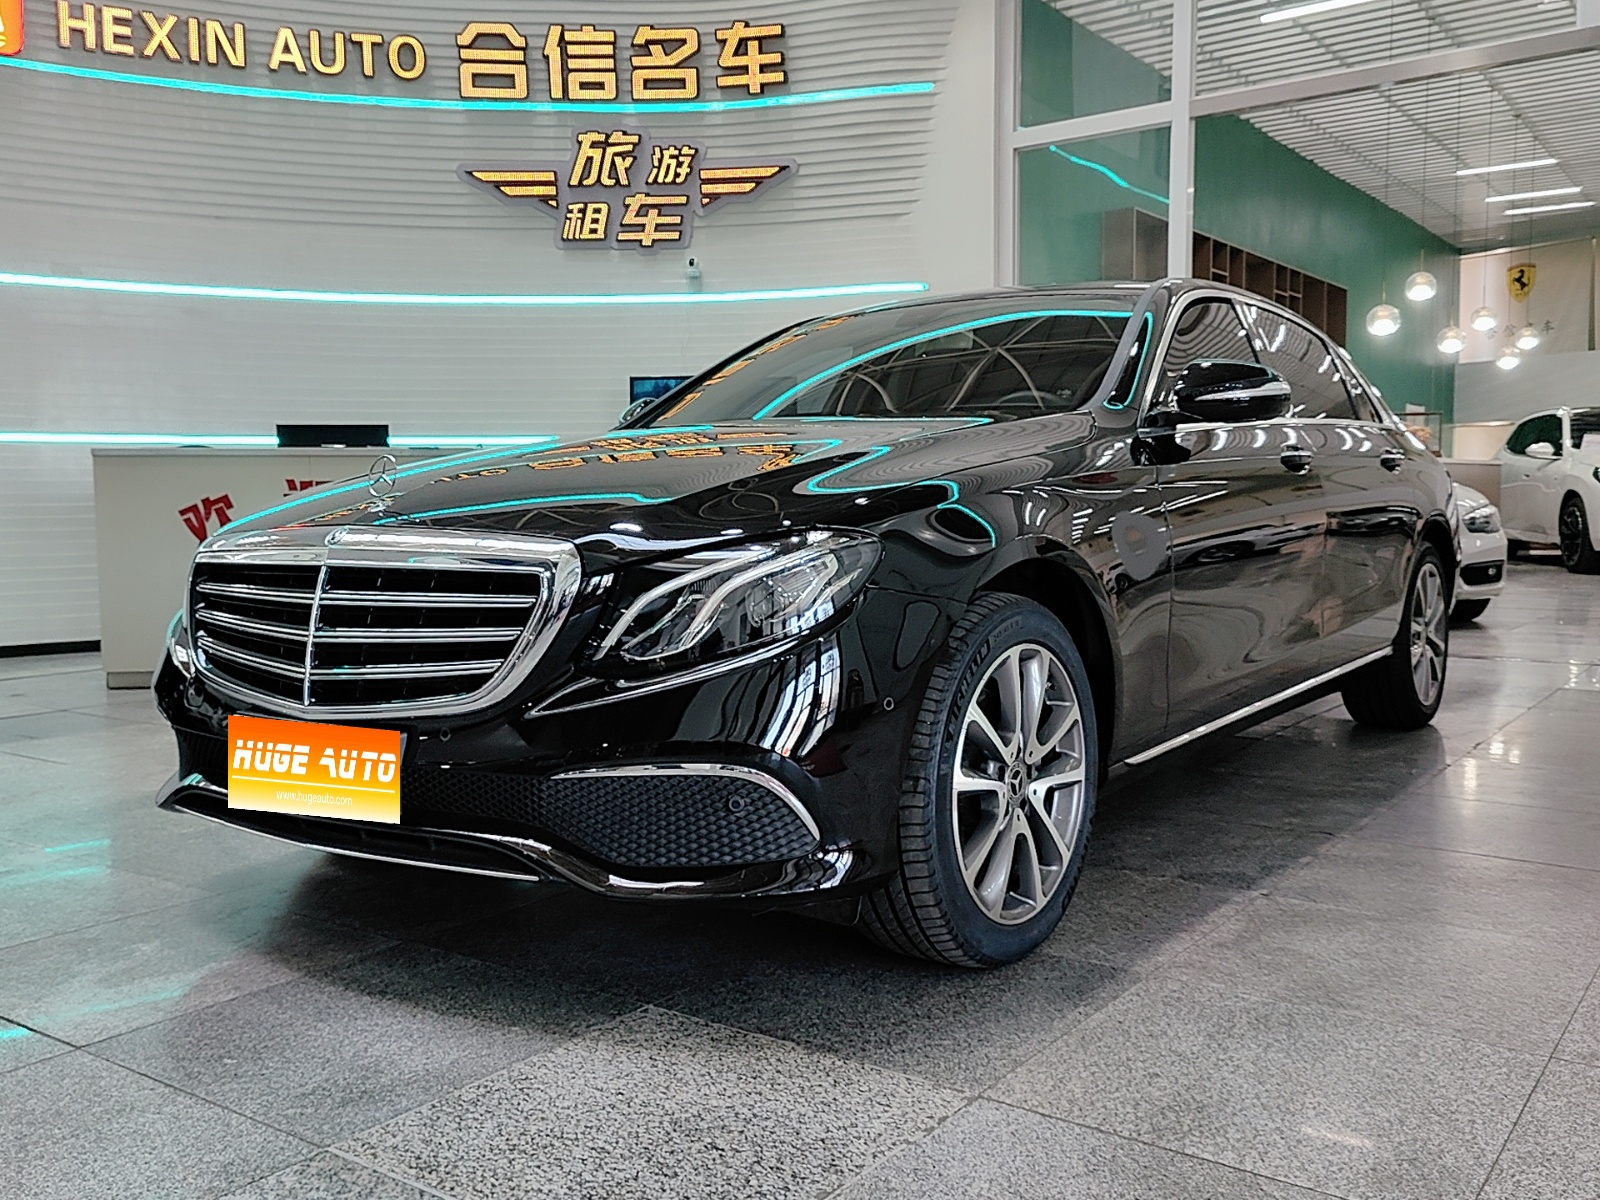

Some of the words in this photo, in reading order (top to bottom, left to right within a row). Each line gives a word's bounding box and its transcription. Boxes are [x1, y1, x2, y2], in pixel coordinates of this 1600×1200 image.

[56, 0, 246, 68] HEXIN
[268, 26, 427, 80] AUTO
[456, 22, 786, 100] 合信名车
[569, 131, 696, 187] 旅游
[562, 193, 688, 247] 租车
